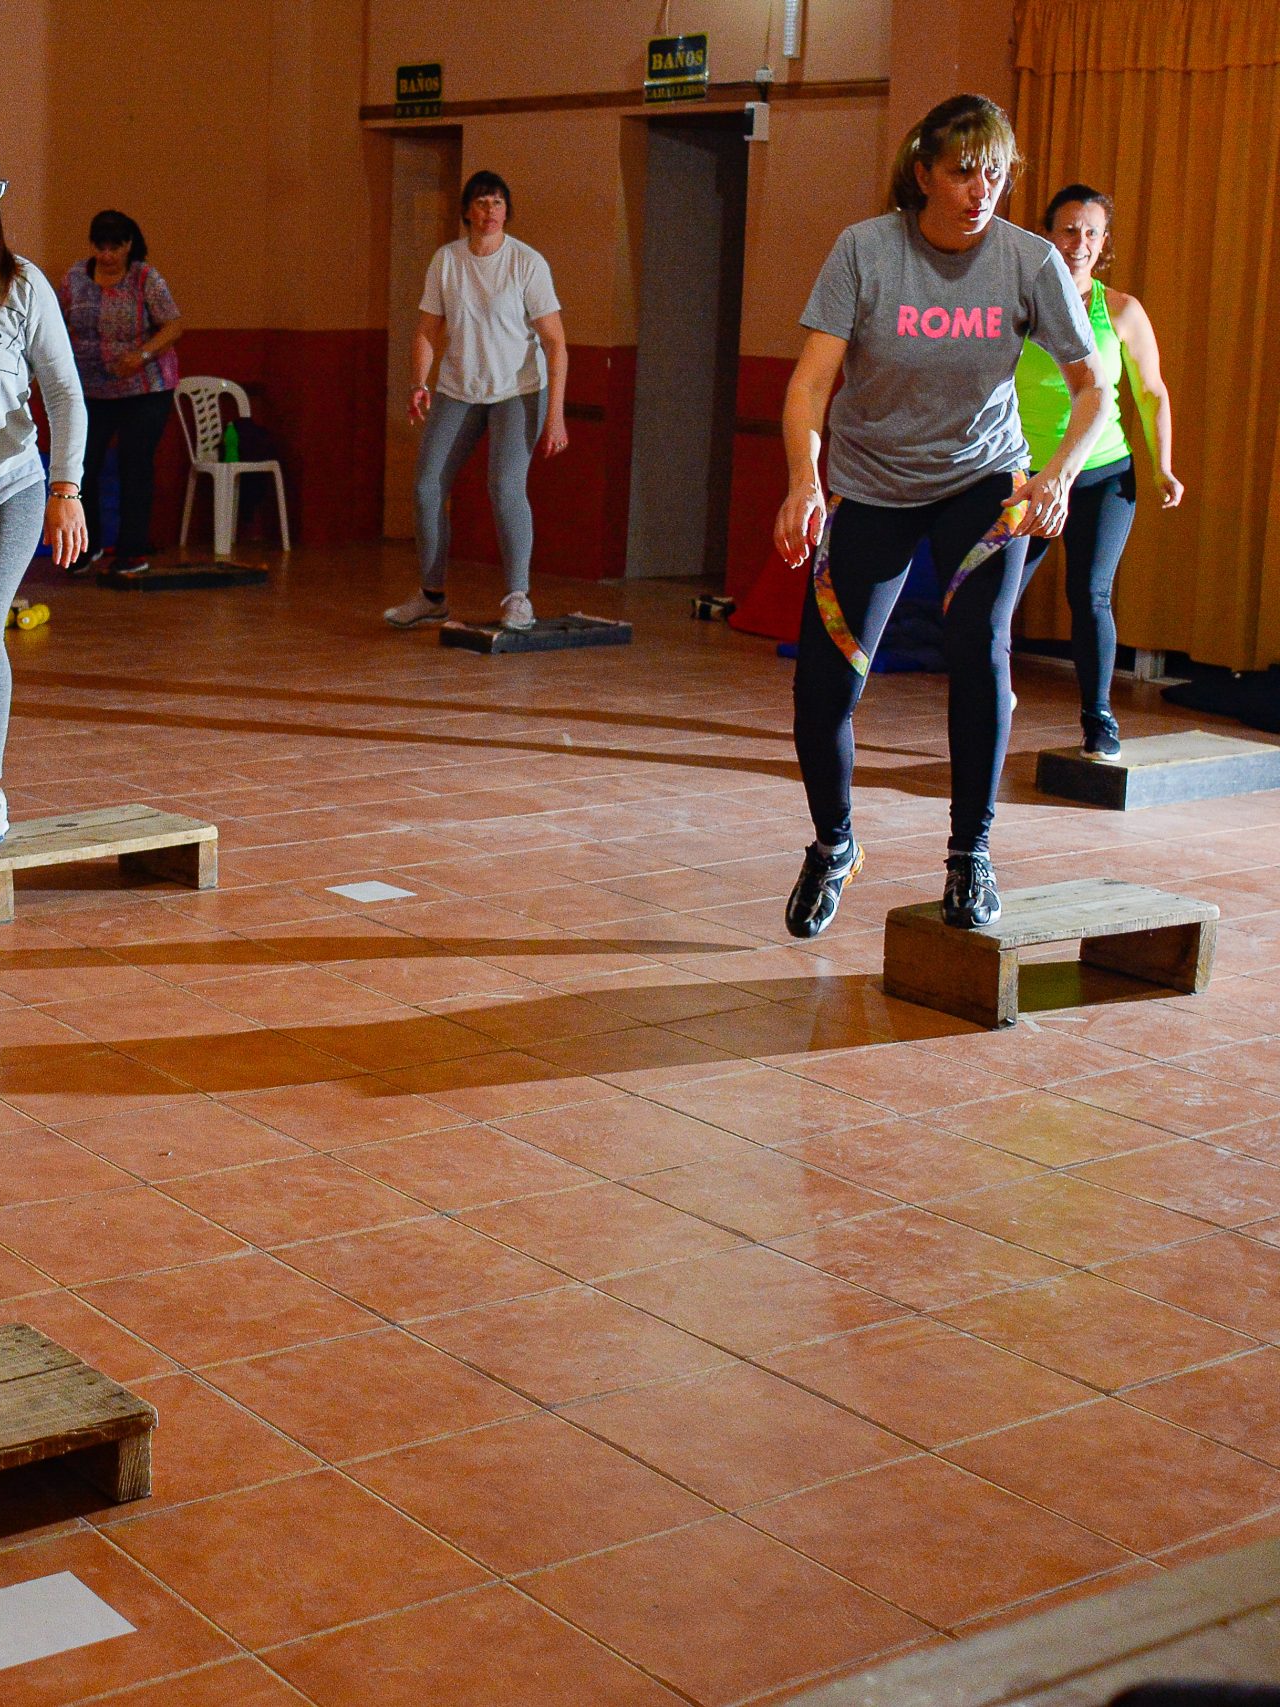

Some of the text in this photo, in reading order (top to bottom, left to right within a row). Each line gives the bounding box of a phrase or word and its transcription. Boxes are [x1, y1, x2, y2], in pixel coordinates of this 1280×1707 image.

[652, 45, 704, 70] BAÑOS
[400, 72, 439, 94] BAÑOS
[896, 304, 1003, 340] ROME
